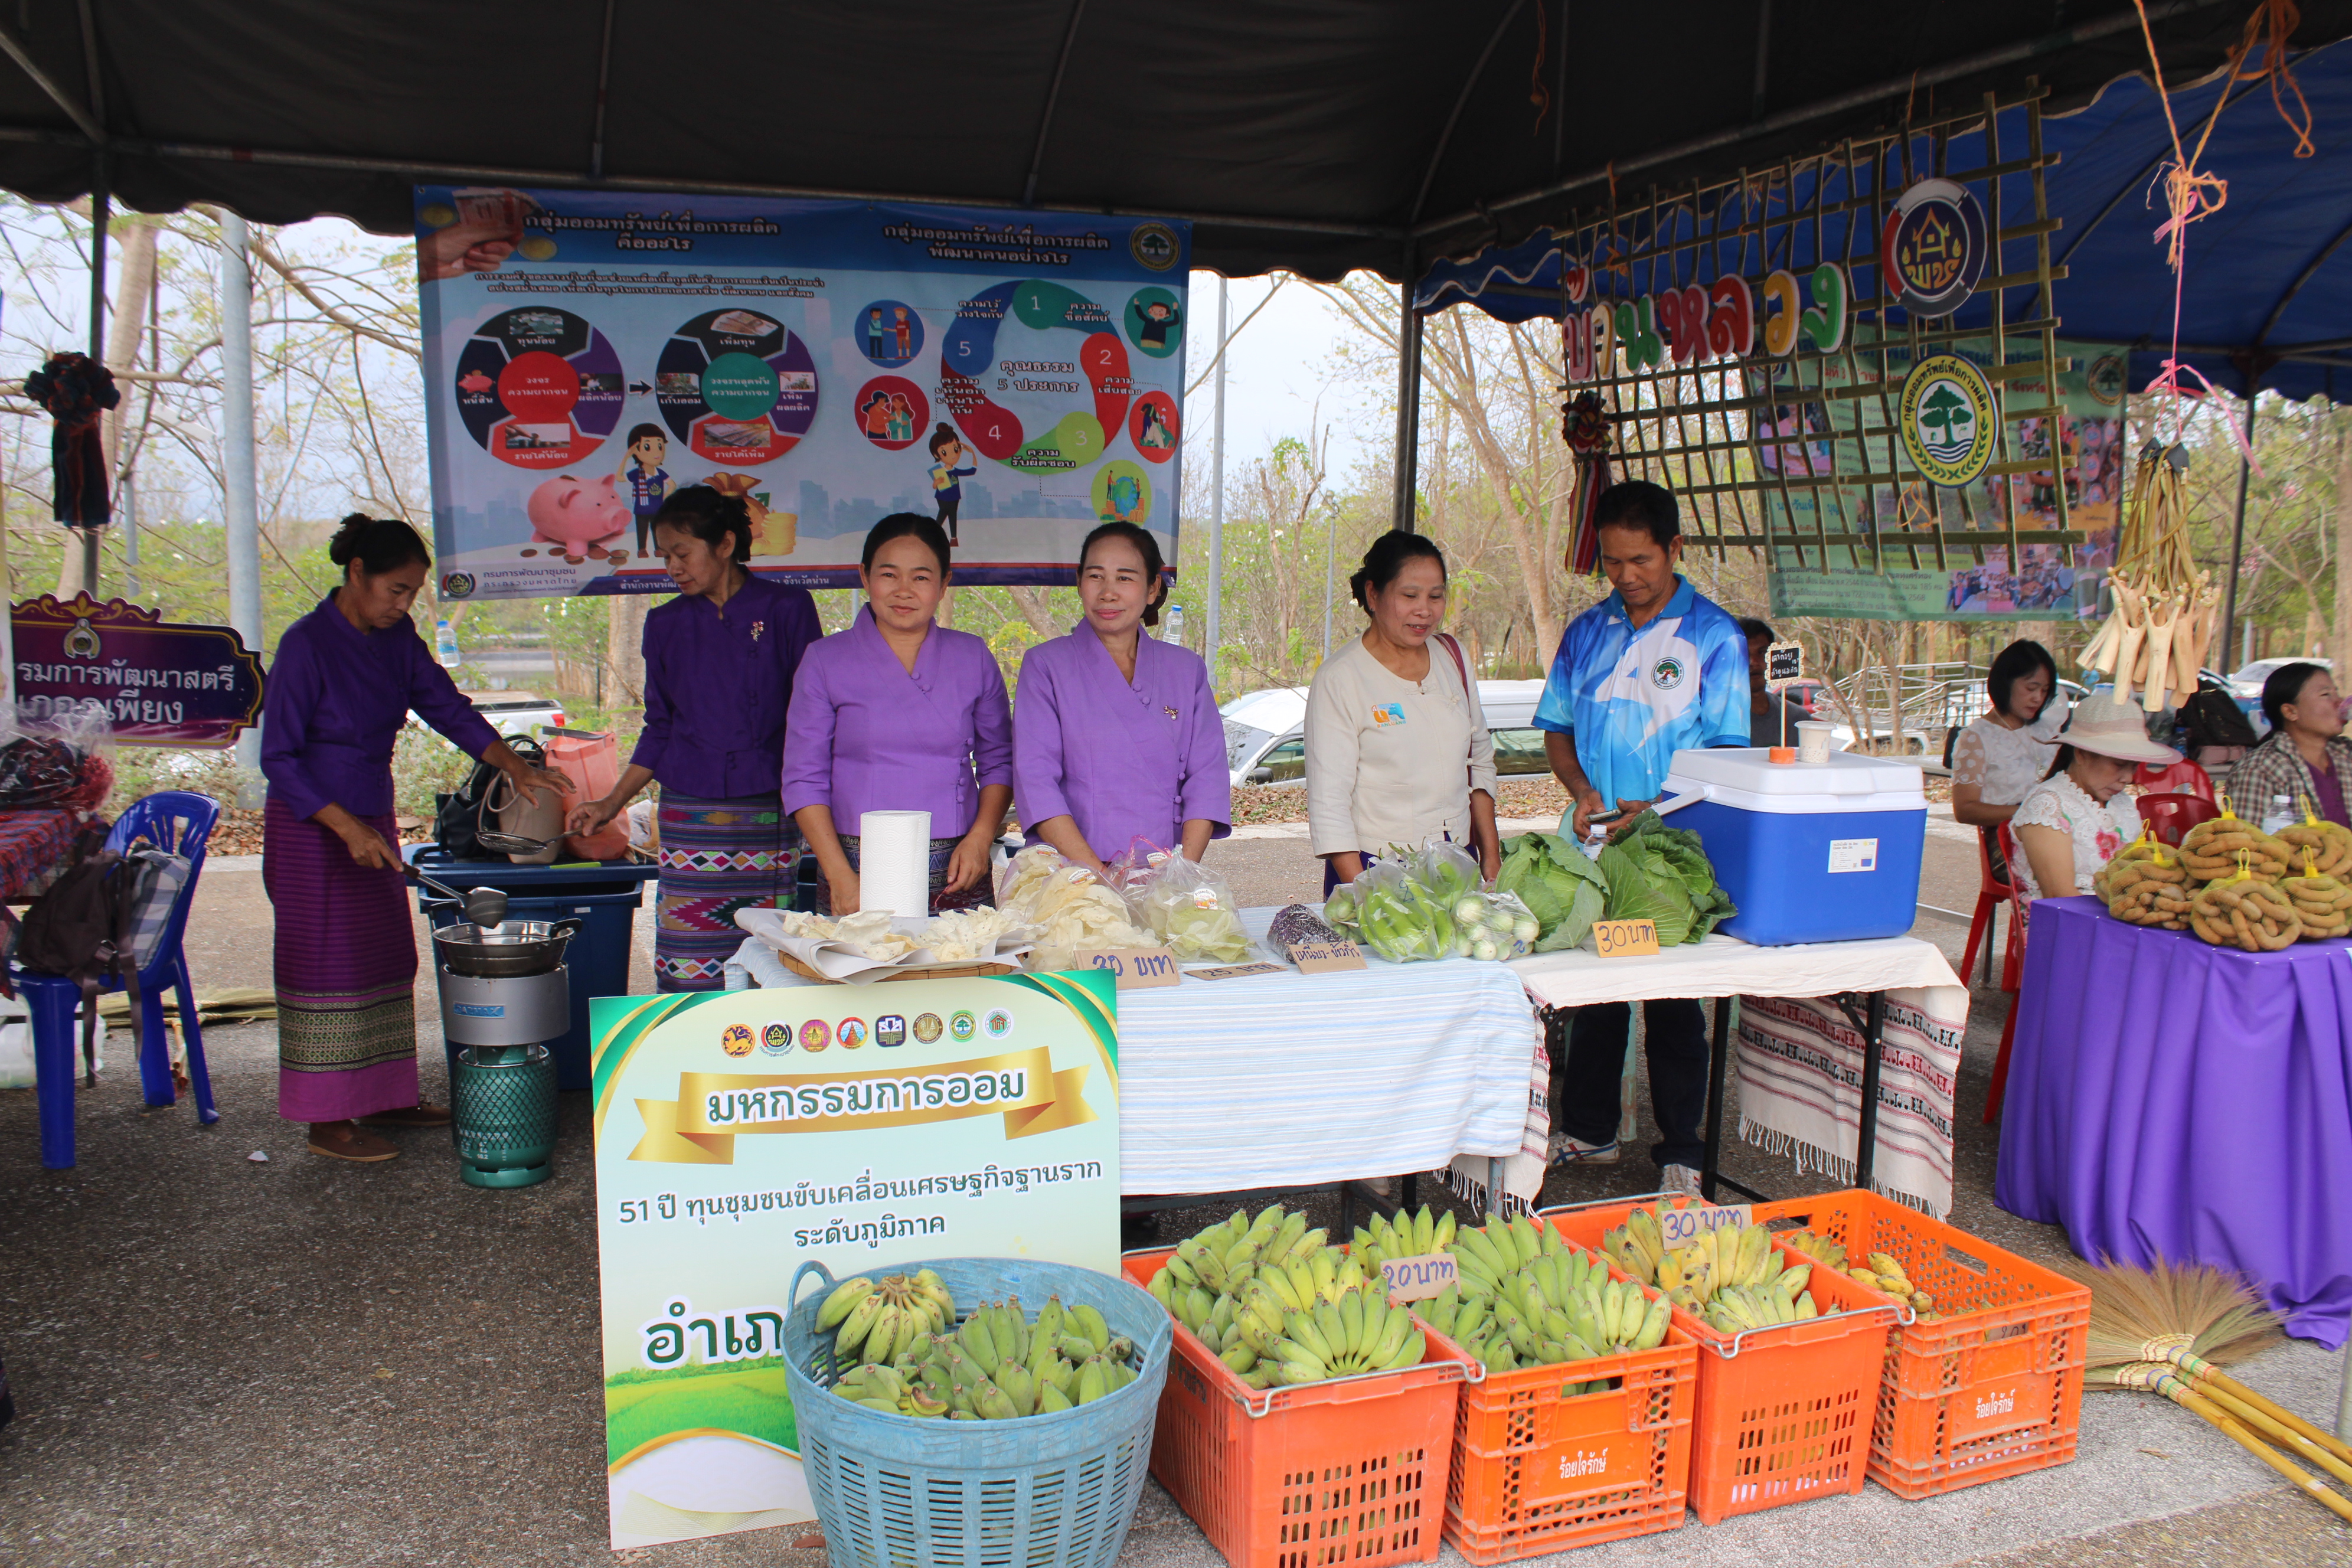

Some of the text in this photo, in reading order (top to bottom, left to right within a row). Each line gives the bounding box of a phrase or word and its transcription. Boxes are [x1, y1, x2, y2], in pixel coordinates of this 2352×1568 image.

[524, 210, 779, 234] กลุ่มออมทรัพย์เพื่อการผลิต
[618, 233, 691, 249] คืออะไร
[883, 223, 1110, 250] กลุ่มออมทรัพย์เพื่อการผลิต
[929, 241, 1070, 264] พัฒนาคนอย่างไร
[1031, 296, 1040, 311] 1
[1562, 262, 1845, 381] บ้านหลวง
[959, 340, 972, 357] 5
[1099, 349, 1112, 365] 2
[1000, 360, 1074, 377] คุณธรรม
[997, 378, 1079, 393] 5 ประการ
[988, 424, 1002, 440] 4
[1075, 430, 1088, 446] 3
[483, 567, 576, 578] กรมการพัฒนาชุมชน
[17, 659, 234, 691] รมการพัฒนาสตรี
[1134, 954, 1175, 976] บาท
[1202, 966, 1232, 977] 25
[708, 1070, 1024, 1122] มหกรรมการออม
[619, 1158, 1103, 1227] 51 ปี ทุนชุมชนขับเคลื่อนเศรษฐกิจฐานราก
[795, 1212, 945, 1249] ระดับภูมิภาค
[646, 1301, 784, 1364] อำเภ
[1975, 1388, 2016, 1419] ร้อยใจรักษ์
[1559, 1447, 1608, 1479] ร้อยใจรักษ์
